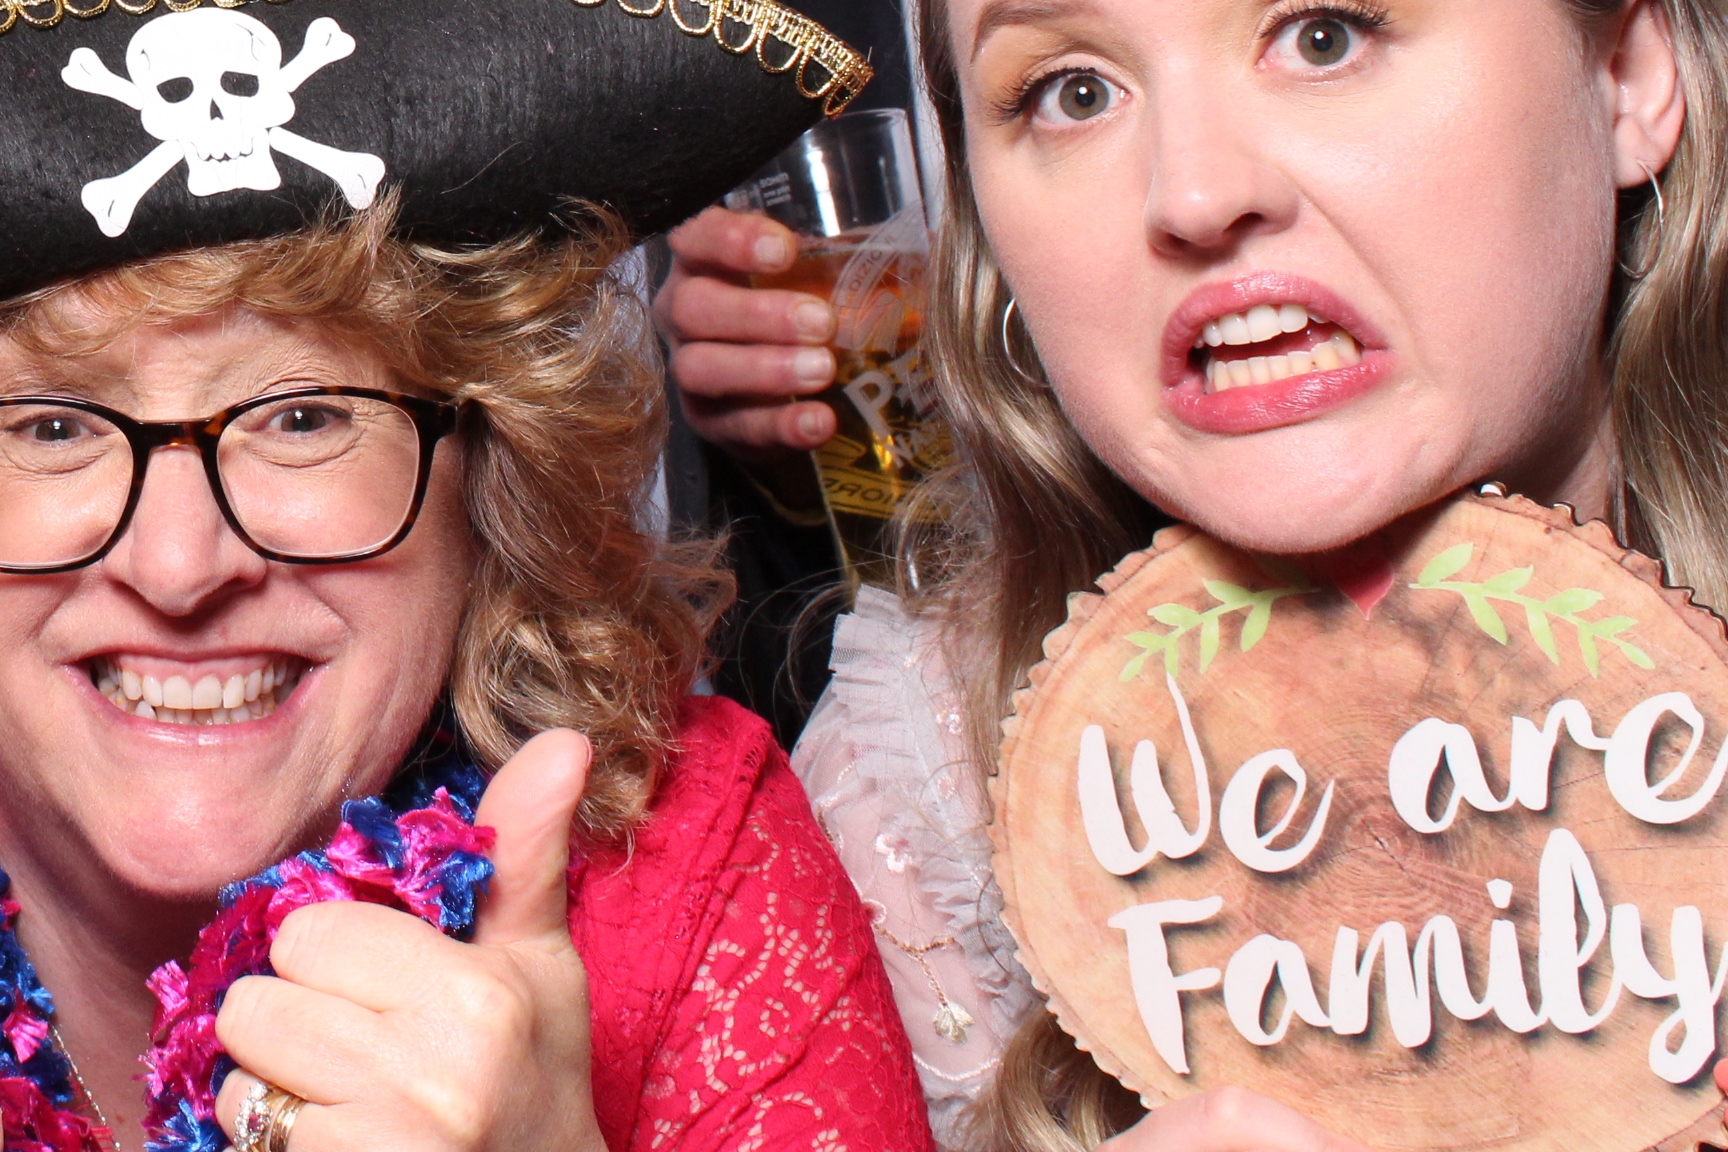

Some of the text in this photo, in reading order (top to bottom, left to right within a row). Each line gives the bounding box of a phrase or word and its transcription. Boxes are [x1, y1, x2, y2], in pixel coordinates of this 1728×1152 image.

[1077, 672, 1728, 876] We are
[1107, 827, 1728, 1085] Family
